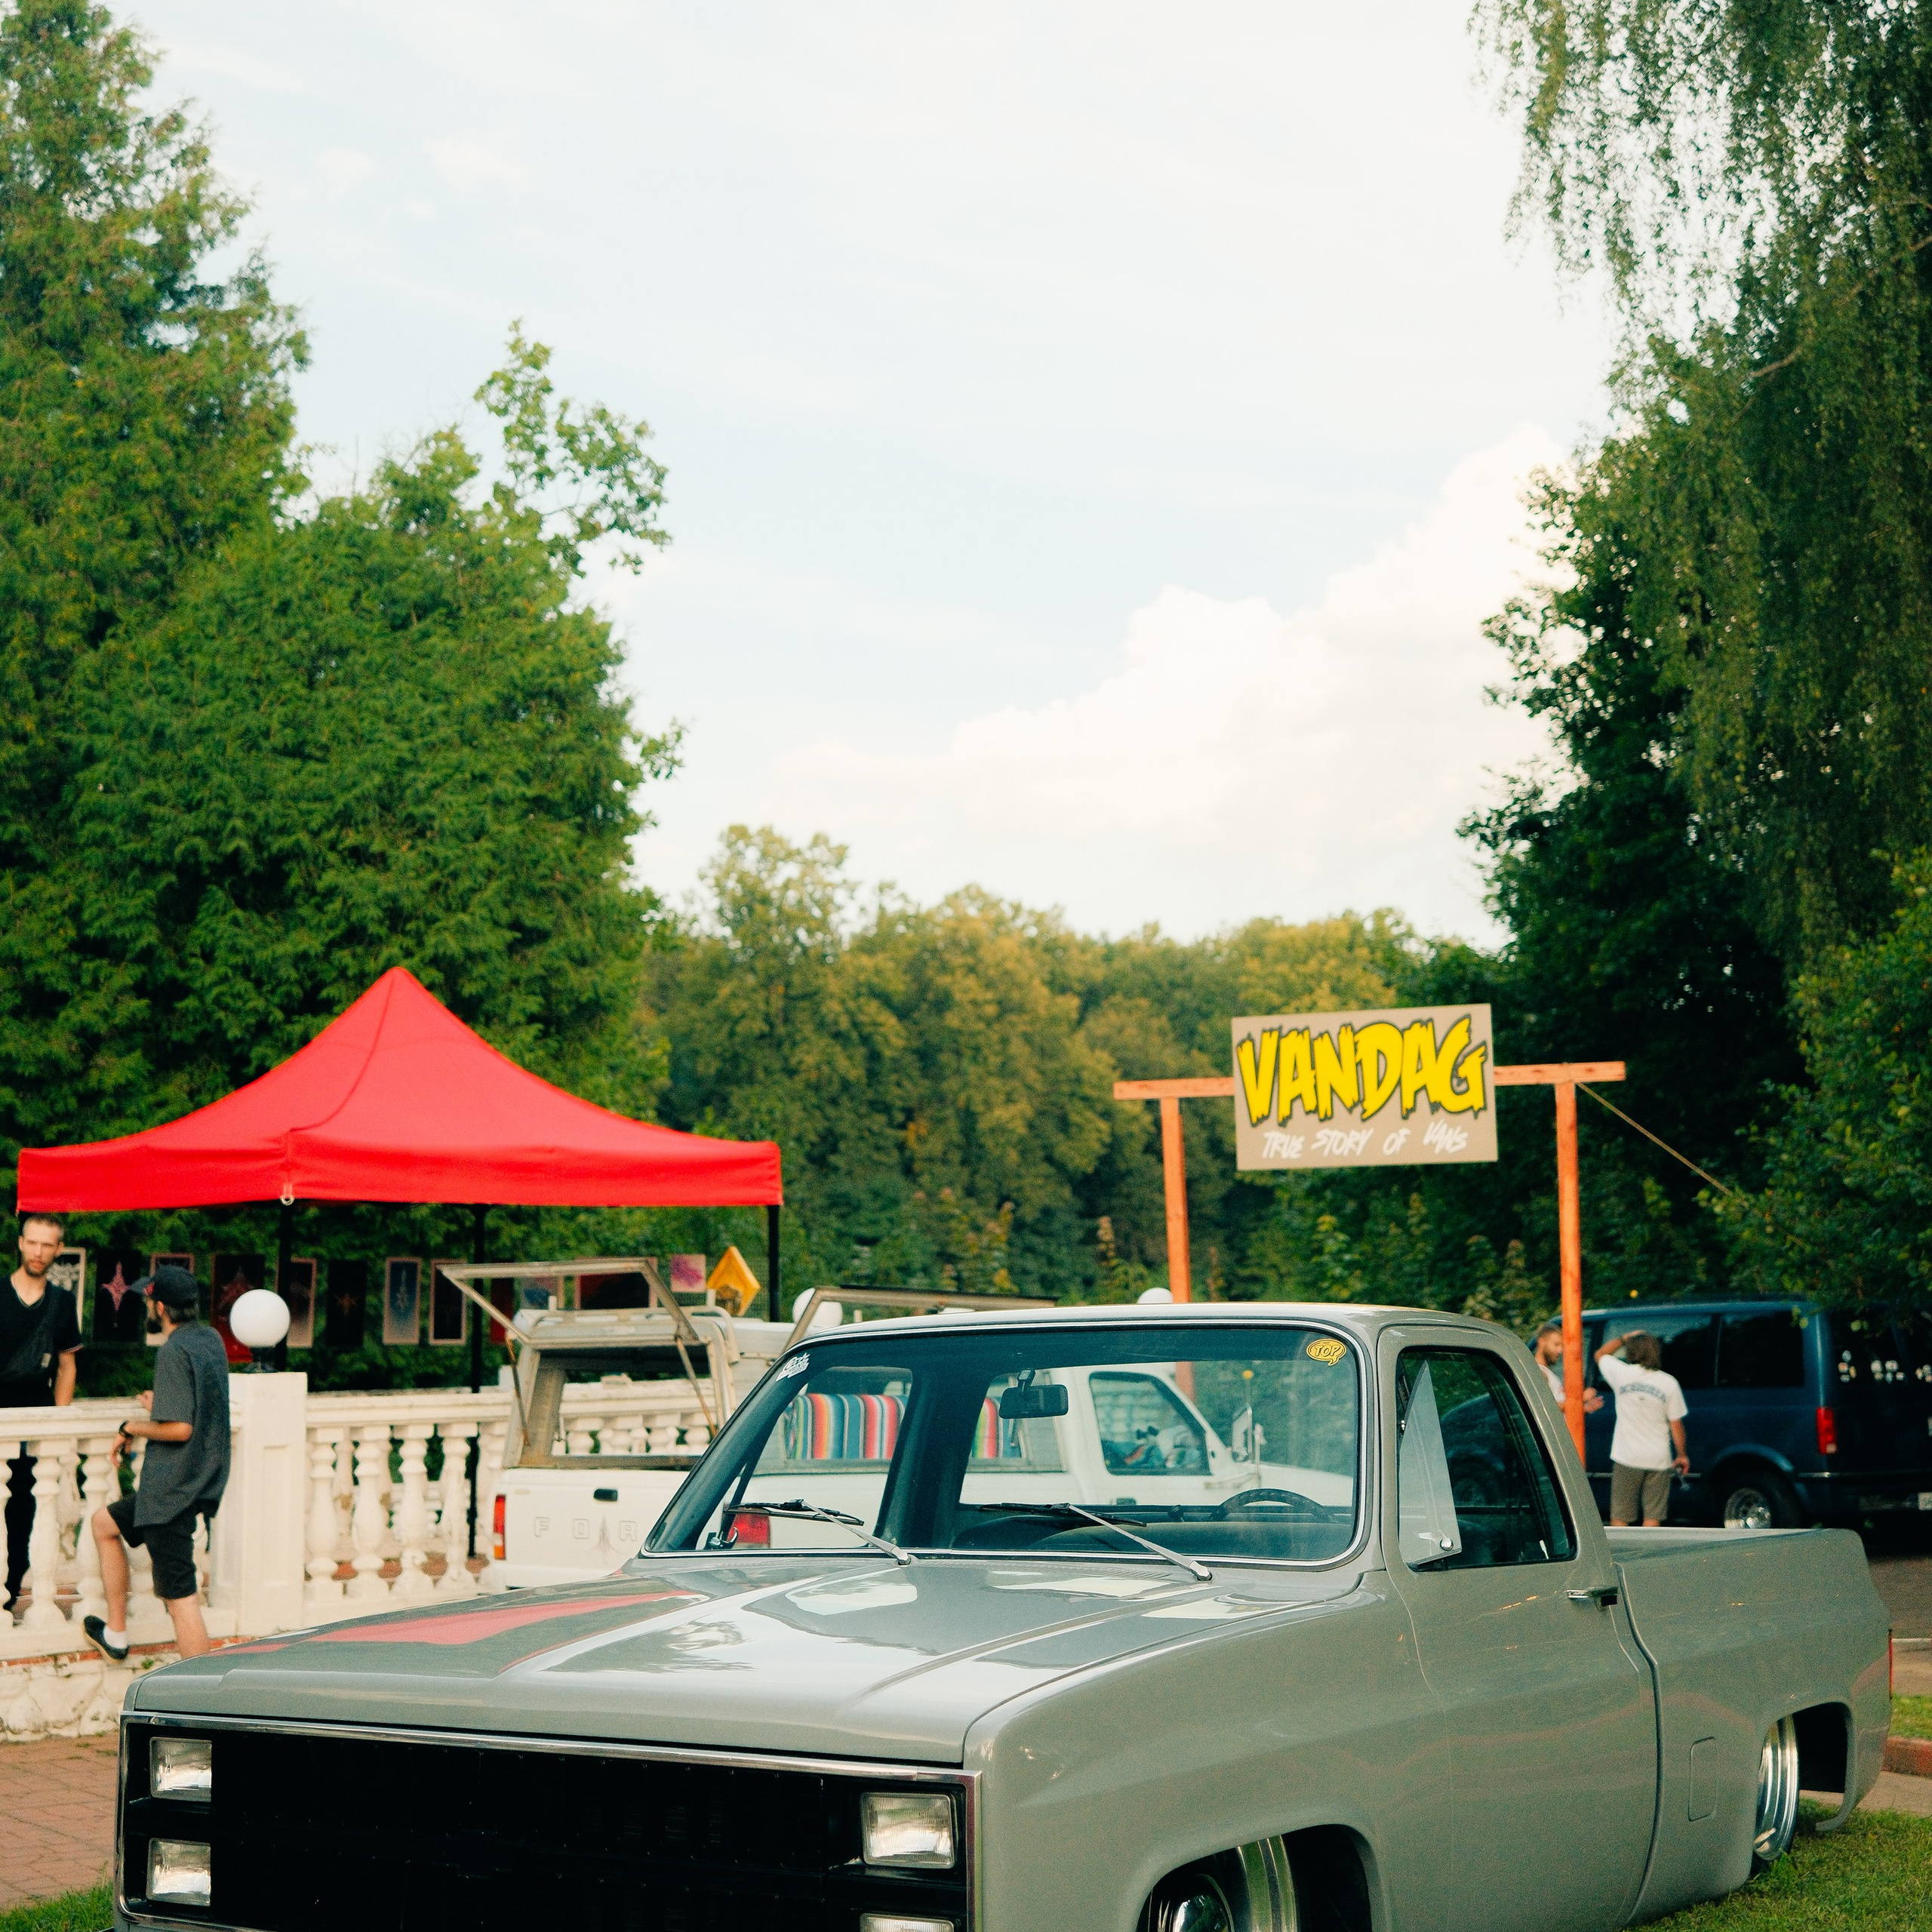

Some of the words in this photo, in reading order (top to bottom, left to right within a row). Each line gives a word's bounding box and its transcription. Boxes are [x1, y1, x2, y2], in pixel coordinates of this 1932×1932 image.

[1237, 1014, 1487, 1126] VANDAG
[1262, 1130, 1305, 1159] TRUE
[1311, 1128, 1374, 1157] STORY
[1383, 1128, 1411, 1155] OF
[1315, 1344, 1340, 1357] TOP
[534, 1517, 638, 1541] FOR
